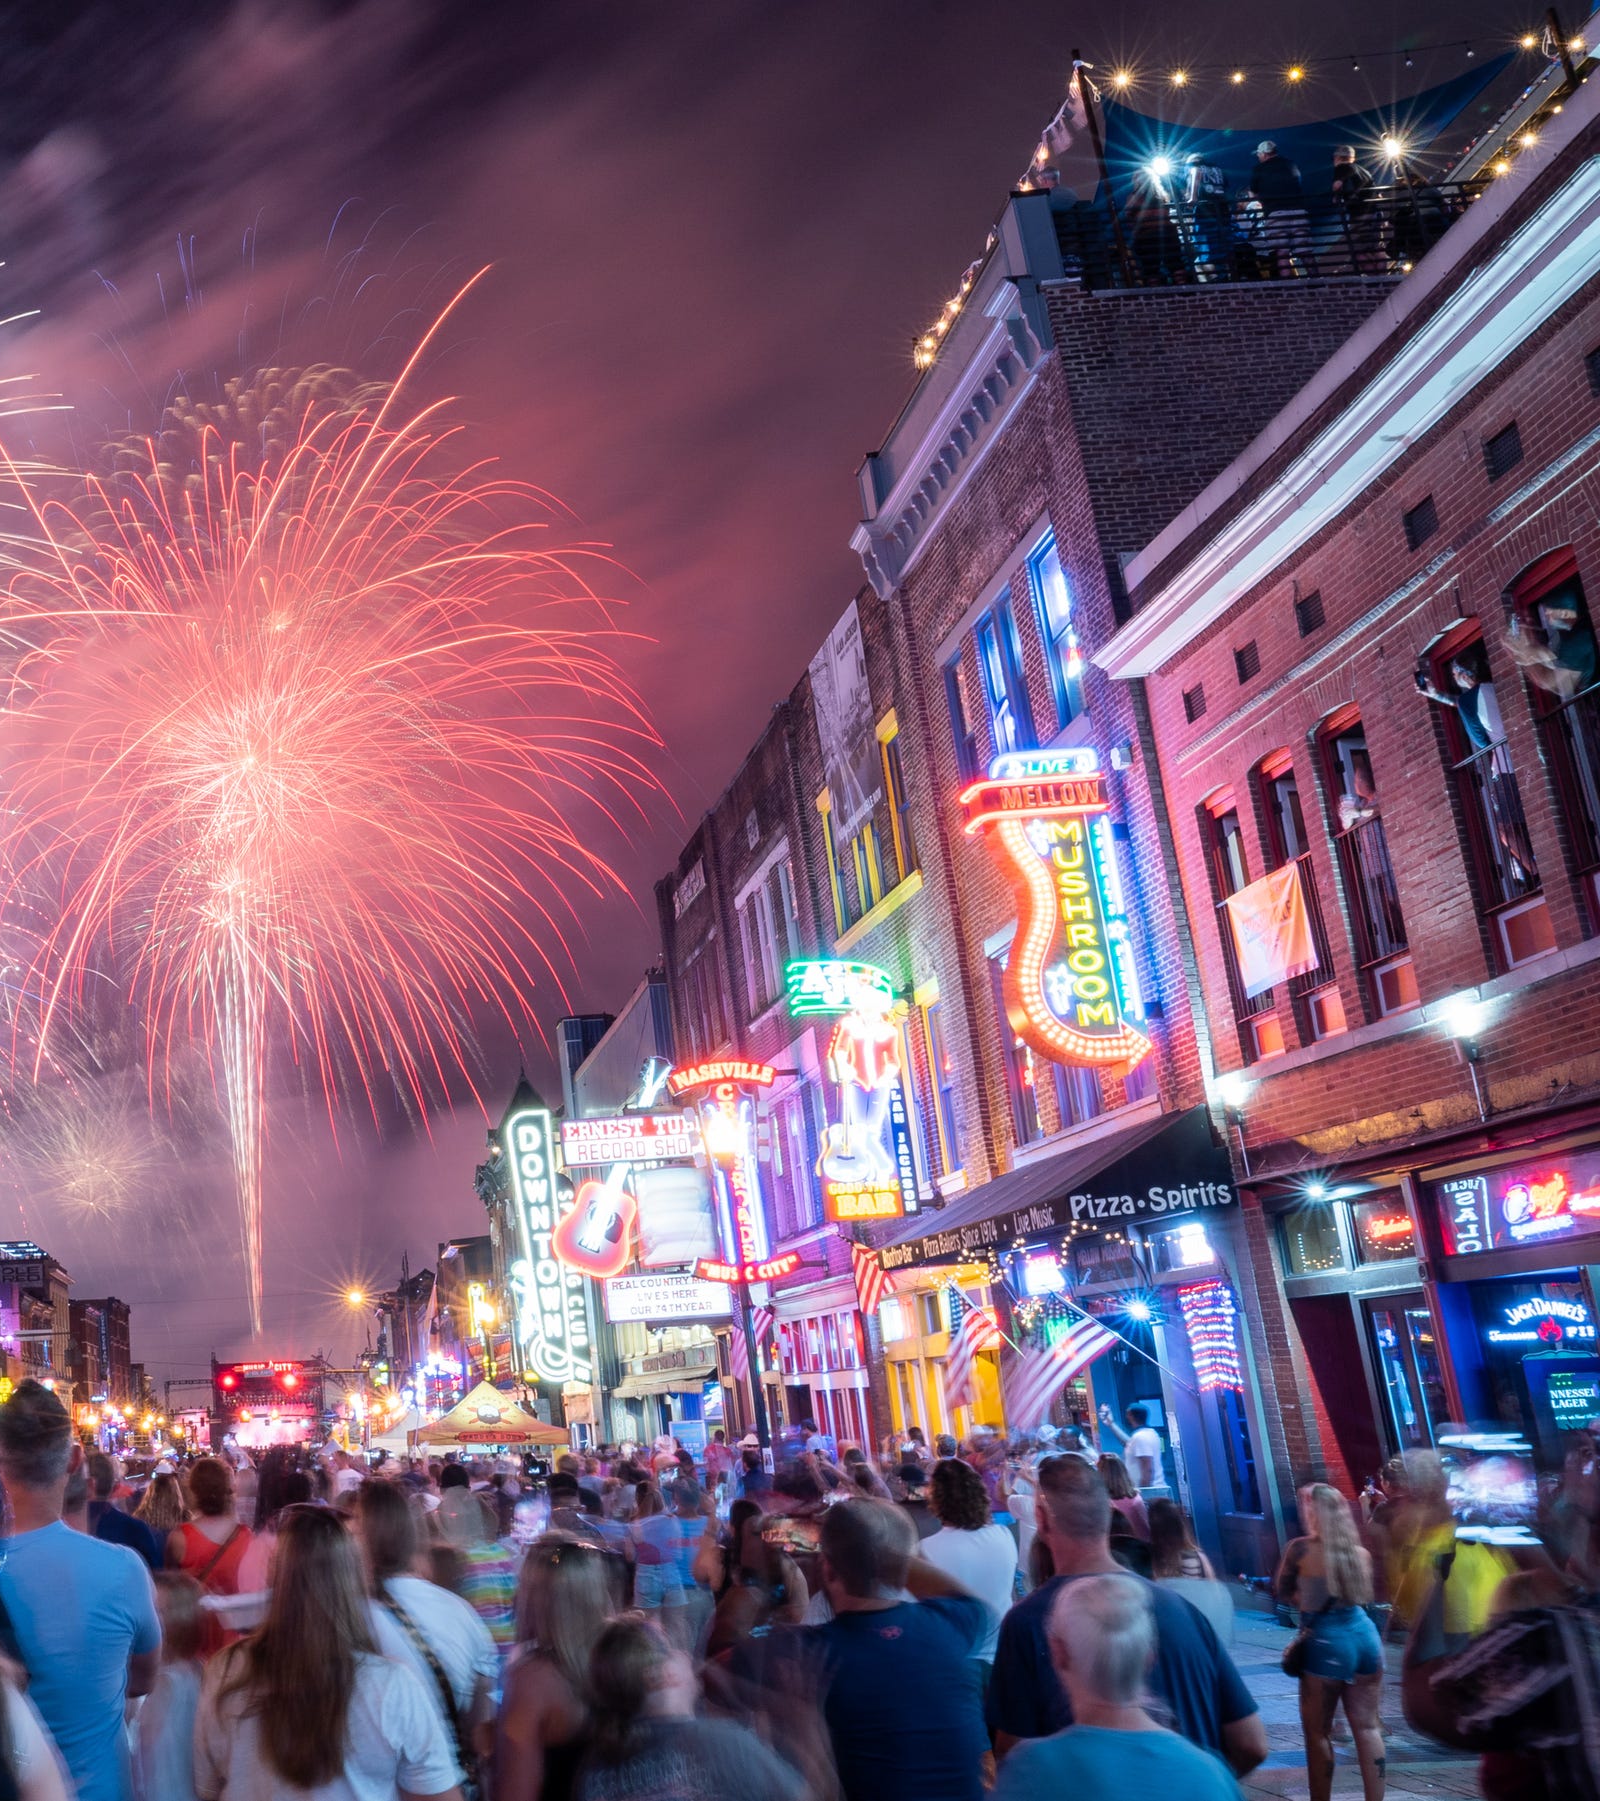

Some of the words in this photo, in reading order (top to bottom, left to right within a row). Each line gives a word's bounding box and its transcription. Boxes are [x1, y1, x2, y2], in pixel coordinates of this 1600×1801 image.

[1026, 759, 1069, 775] LIVE
[1000, 779, 1099, 809] MELLOW
[1048, 820, 1114, 1027] MUSHROOM
[673, 1061, 774, 1089] NASHVILLE
[564, 1117, 644, 1141] ERNEST
[578, 1141, 646, 1161] RECORD
[897, 1131, 917, 1213] JACKSON
[836, 1193, 897, 1217] BAR
[1069, 1194, 1136, 1219] Pizza
[1148, 1181, 1232, 1212] Spirits
[517, 1125, 563, 1338] DOWNTOWN
[902, 1243, 913, 1263] Bar
[923, 1238, 939, 1259] Pizza
[938, 1233, 961, 1255] Bakers
[961, 1226, 979, 1250] Since
[980, 1219, 998, 1245] 1974
[1013, 1212, 1031, 1235] Live
[1029, 1203, 1055, 1232] Music
[2, 1266, 42, 1275] OLE
[611, 1280, 639, 1291] REAL
[640, 1276, 690, 1288] COUNTRY
[637, 1291, 670, 1301] LIVES
[672, 1288, 699, 1299] HERE
[626, 1305, 653, 1315] OUR
[683, 1301, 713, 1312] YEAR
[1504, 1302, 1534, 1325] JACK
[1530, 1297, 1588, 1322] DANIEL'S
[567, 1295, 588, 1348] CLUB
[243, 1364, 266, 1372] MUSIC
[275, 1362, 292, 1372] CITY
[1551, 1398, 1589, 1409] LAGER
